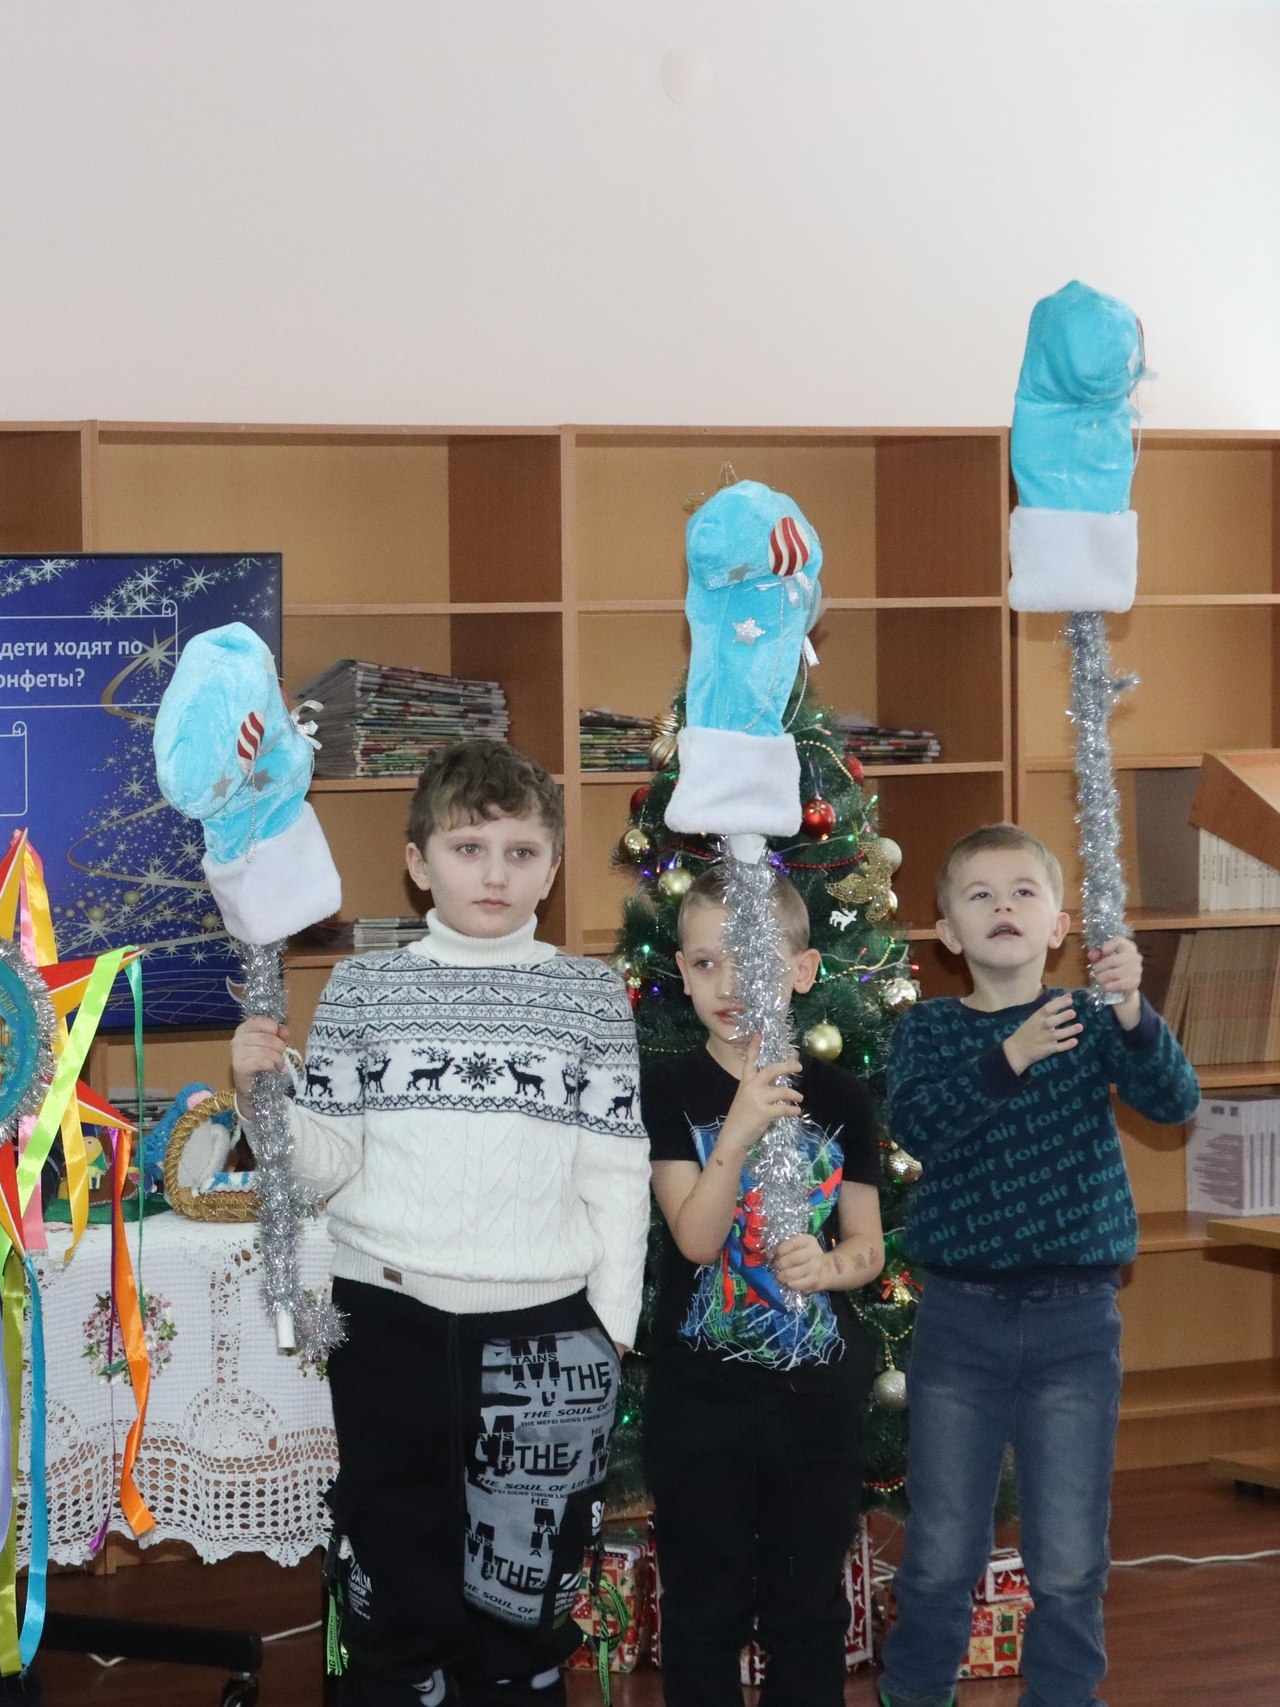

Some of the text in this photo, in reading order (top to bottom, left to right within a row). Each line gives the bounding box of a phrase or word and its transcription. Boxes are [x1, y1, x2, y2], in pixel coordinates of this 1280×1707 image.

[0, 641, 48, 660] дети
[54, 640, 113, 660] ходят
[118, 641, 143, 655] по
[1026, 1096, 1084, 1135] force
[1004, 1134, 1064, 1169] force
[1072, 1115, 1100, 1137] air
[991, 1167, 1052, 1201] force
[1056, 1150, 1085, 1172] air
[967, 1201, 1027, 1235] force
[1038, 1184, 1068, 1206] air
[943, 1235, 1003, 1267] force
[1015, 1218, 1046, 1240] air
[1056, 1195, 1109, 1228] force
[512, 1353, 558, 1365] TAINS
[561, 1361, 610, 1392] THE
[522, 1410, 552, 1419] THE
[556, 1406, 593, 1417] SOUL
[515, 1442, 569, 1470] THE
[504, 1482, 543, 1492] SOUL
[548, 1484, 568, 1492] OF
[531, 1497, 549, 1507] HE
[494, 1555, 544, 1589] THE
[482, 1591, 513, 1609] SOUL
[518, 1605, 537, 1614] OF
